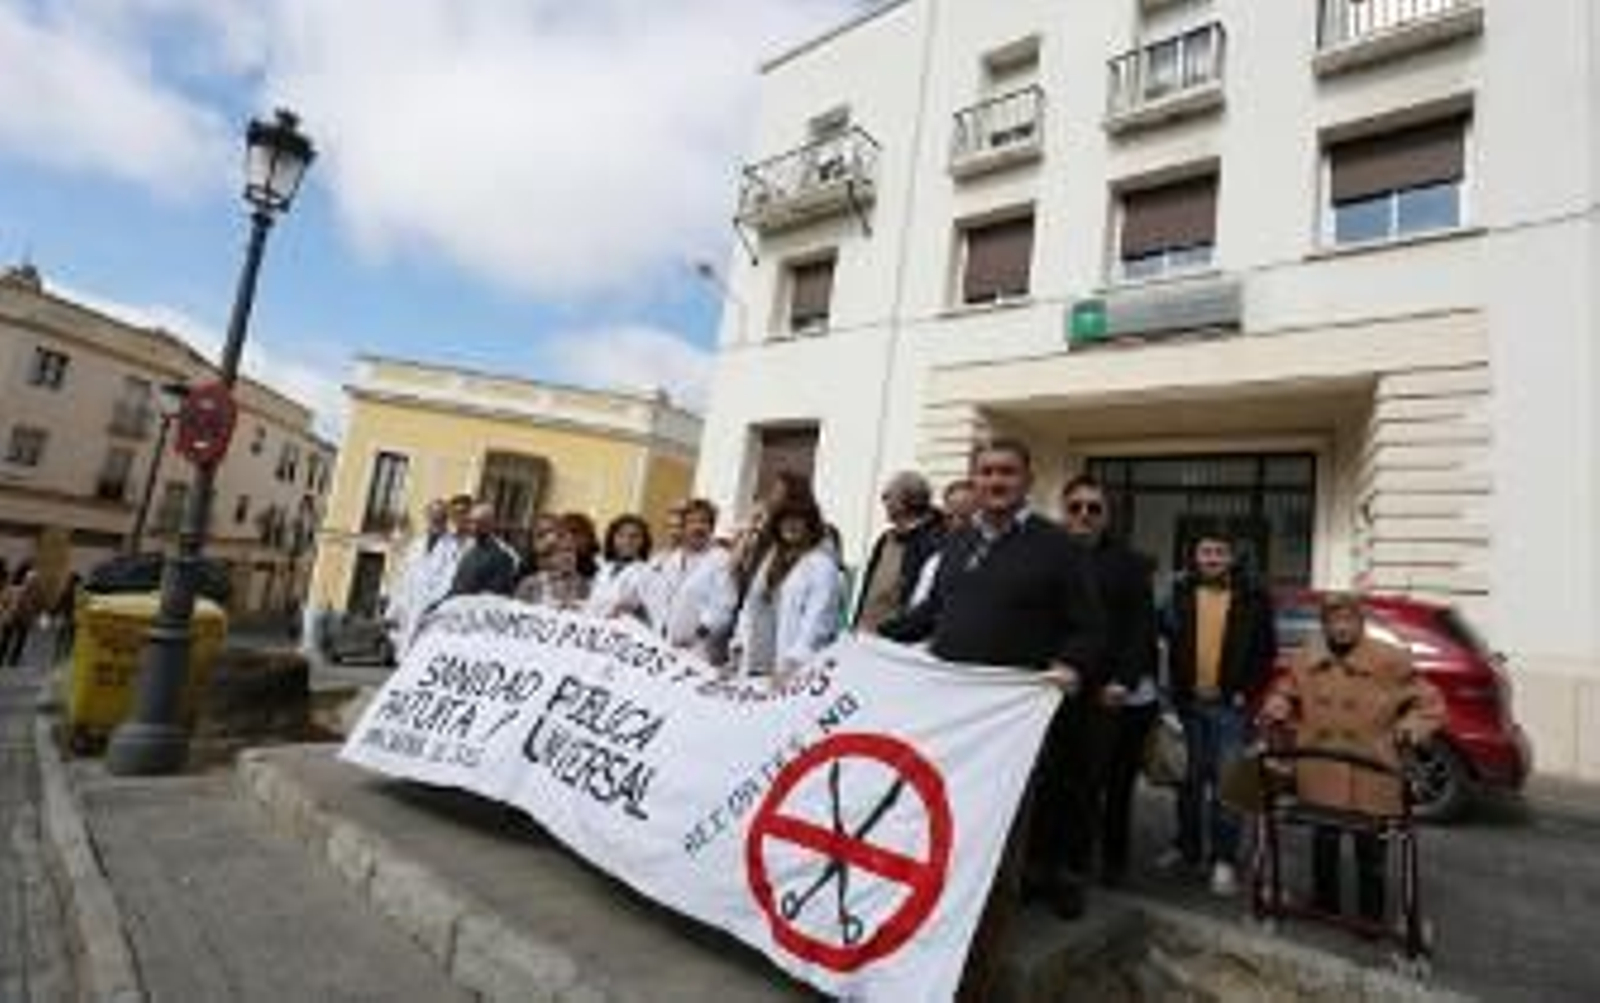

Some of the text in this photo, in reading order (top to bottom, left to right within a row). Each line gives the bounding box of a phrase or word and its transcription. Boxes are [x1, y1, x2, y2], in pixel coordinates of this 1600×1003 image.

[418, 656, 543, 700] SANIDAD
[818, 695, 860, 733] NO
[523, 715, 654, 820] UNIVERSAL
